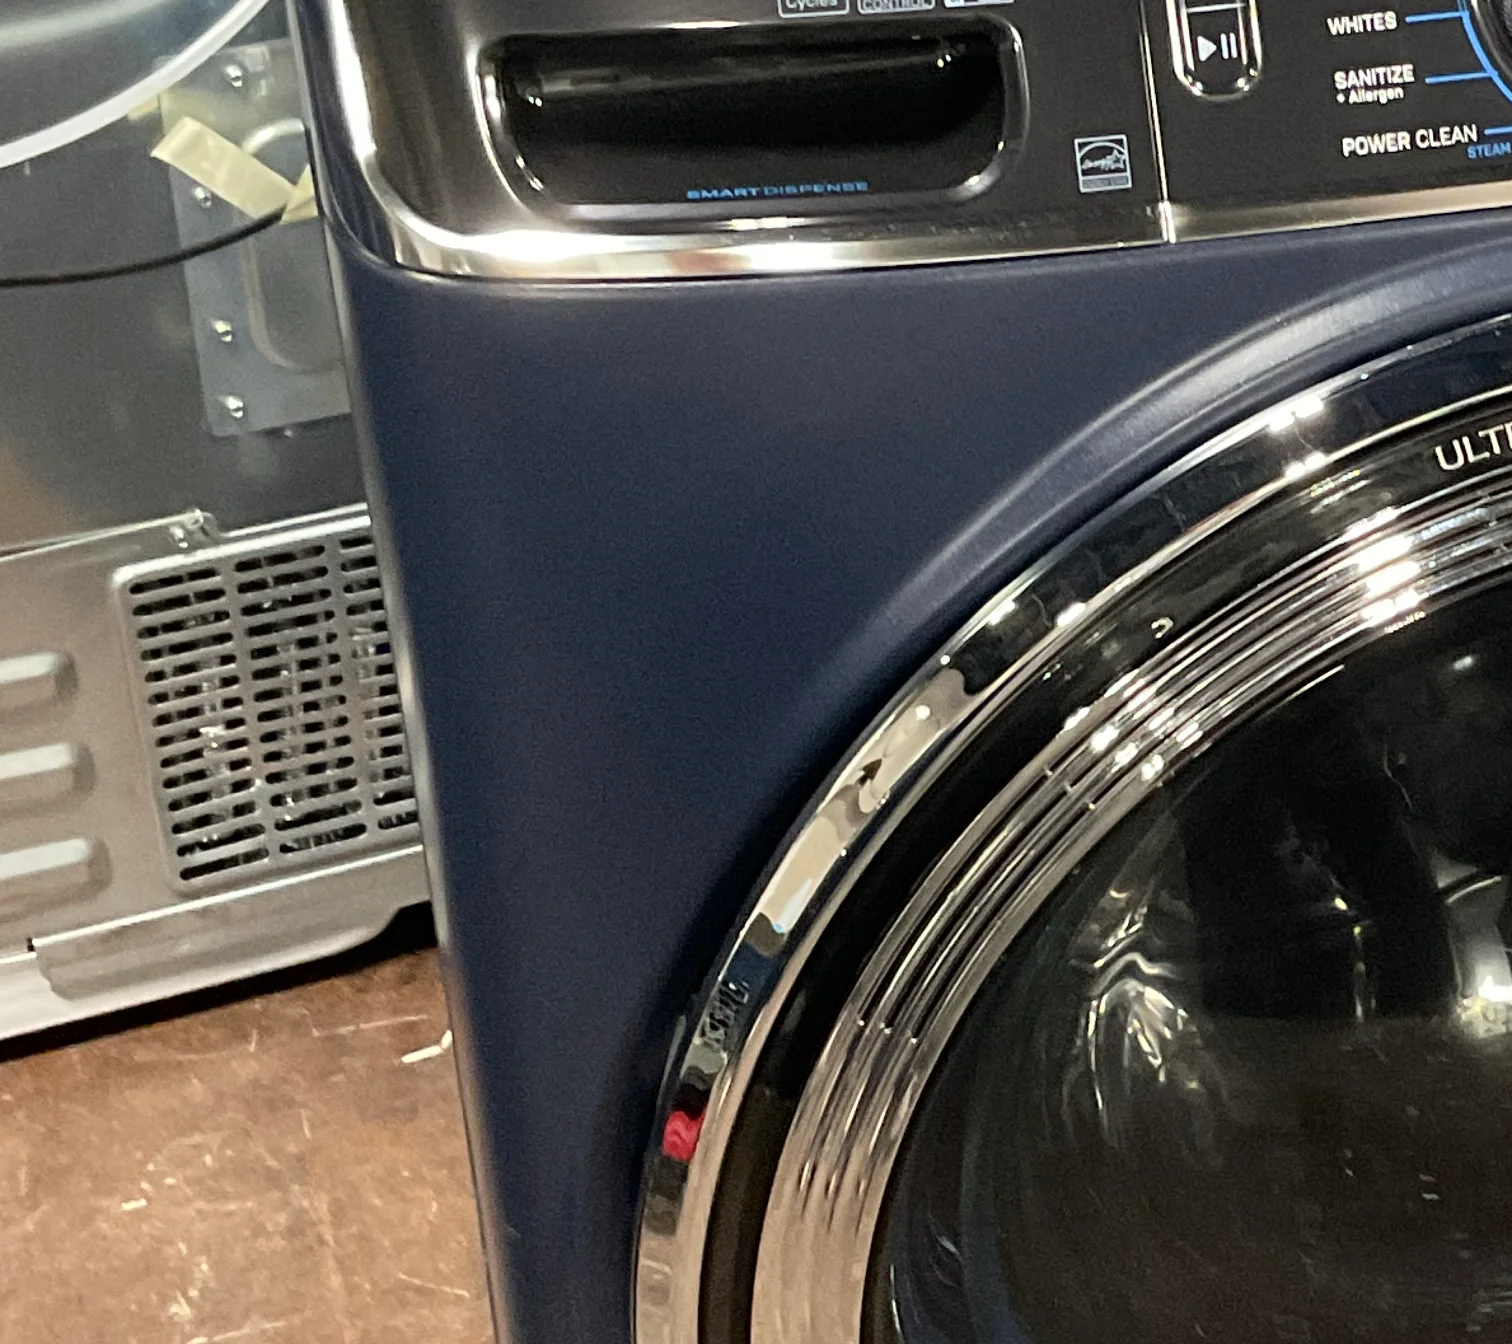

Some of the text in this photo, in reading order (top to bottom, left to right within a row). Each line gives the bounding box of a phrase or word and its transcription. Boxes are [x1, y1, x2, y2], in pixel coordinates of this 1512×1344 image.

[1327, 11, 1398, 36] WHITES
[1334, 63, 1415, 90] SANITIZE
[1348, 87, 1404, 104] Allergen
[1342, 123, 1478, 157] POWER CLEAN
[1467, 141, 1512, 159] STEAM
